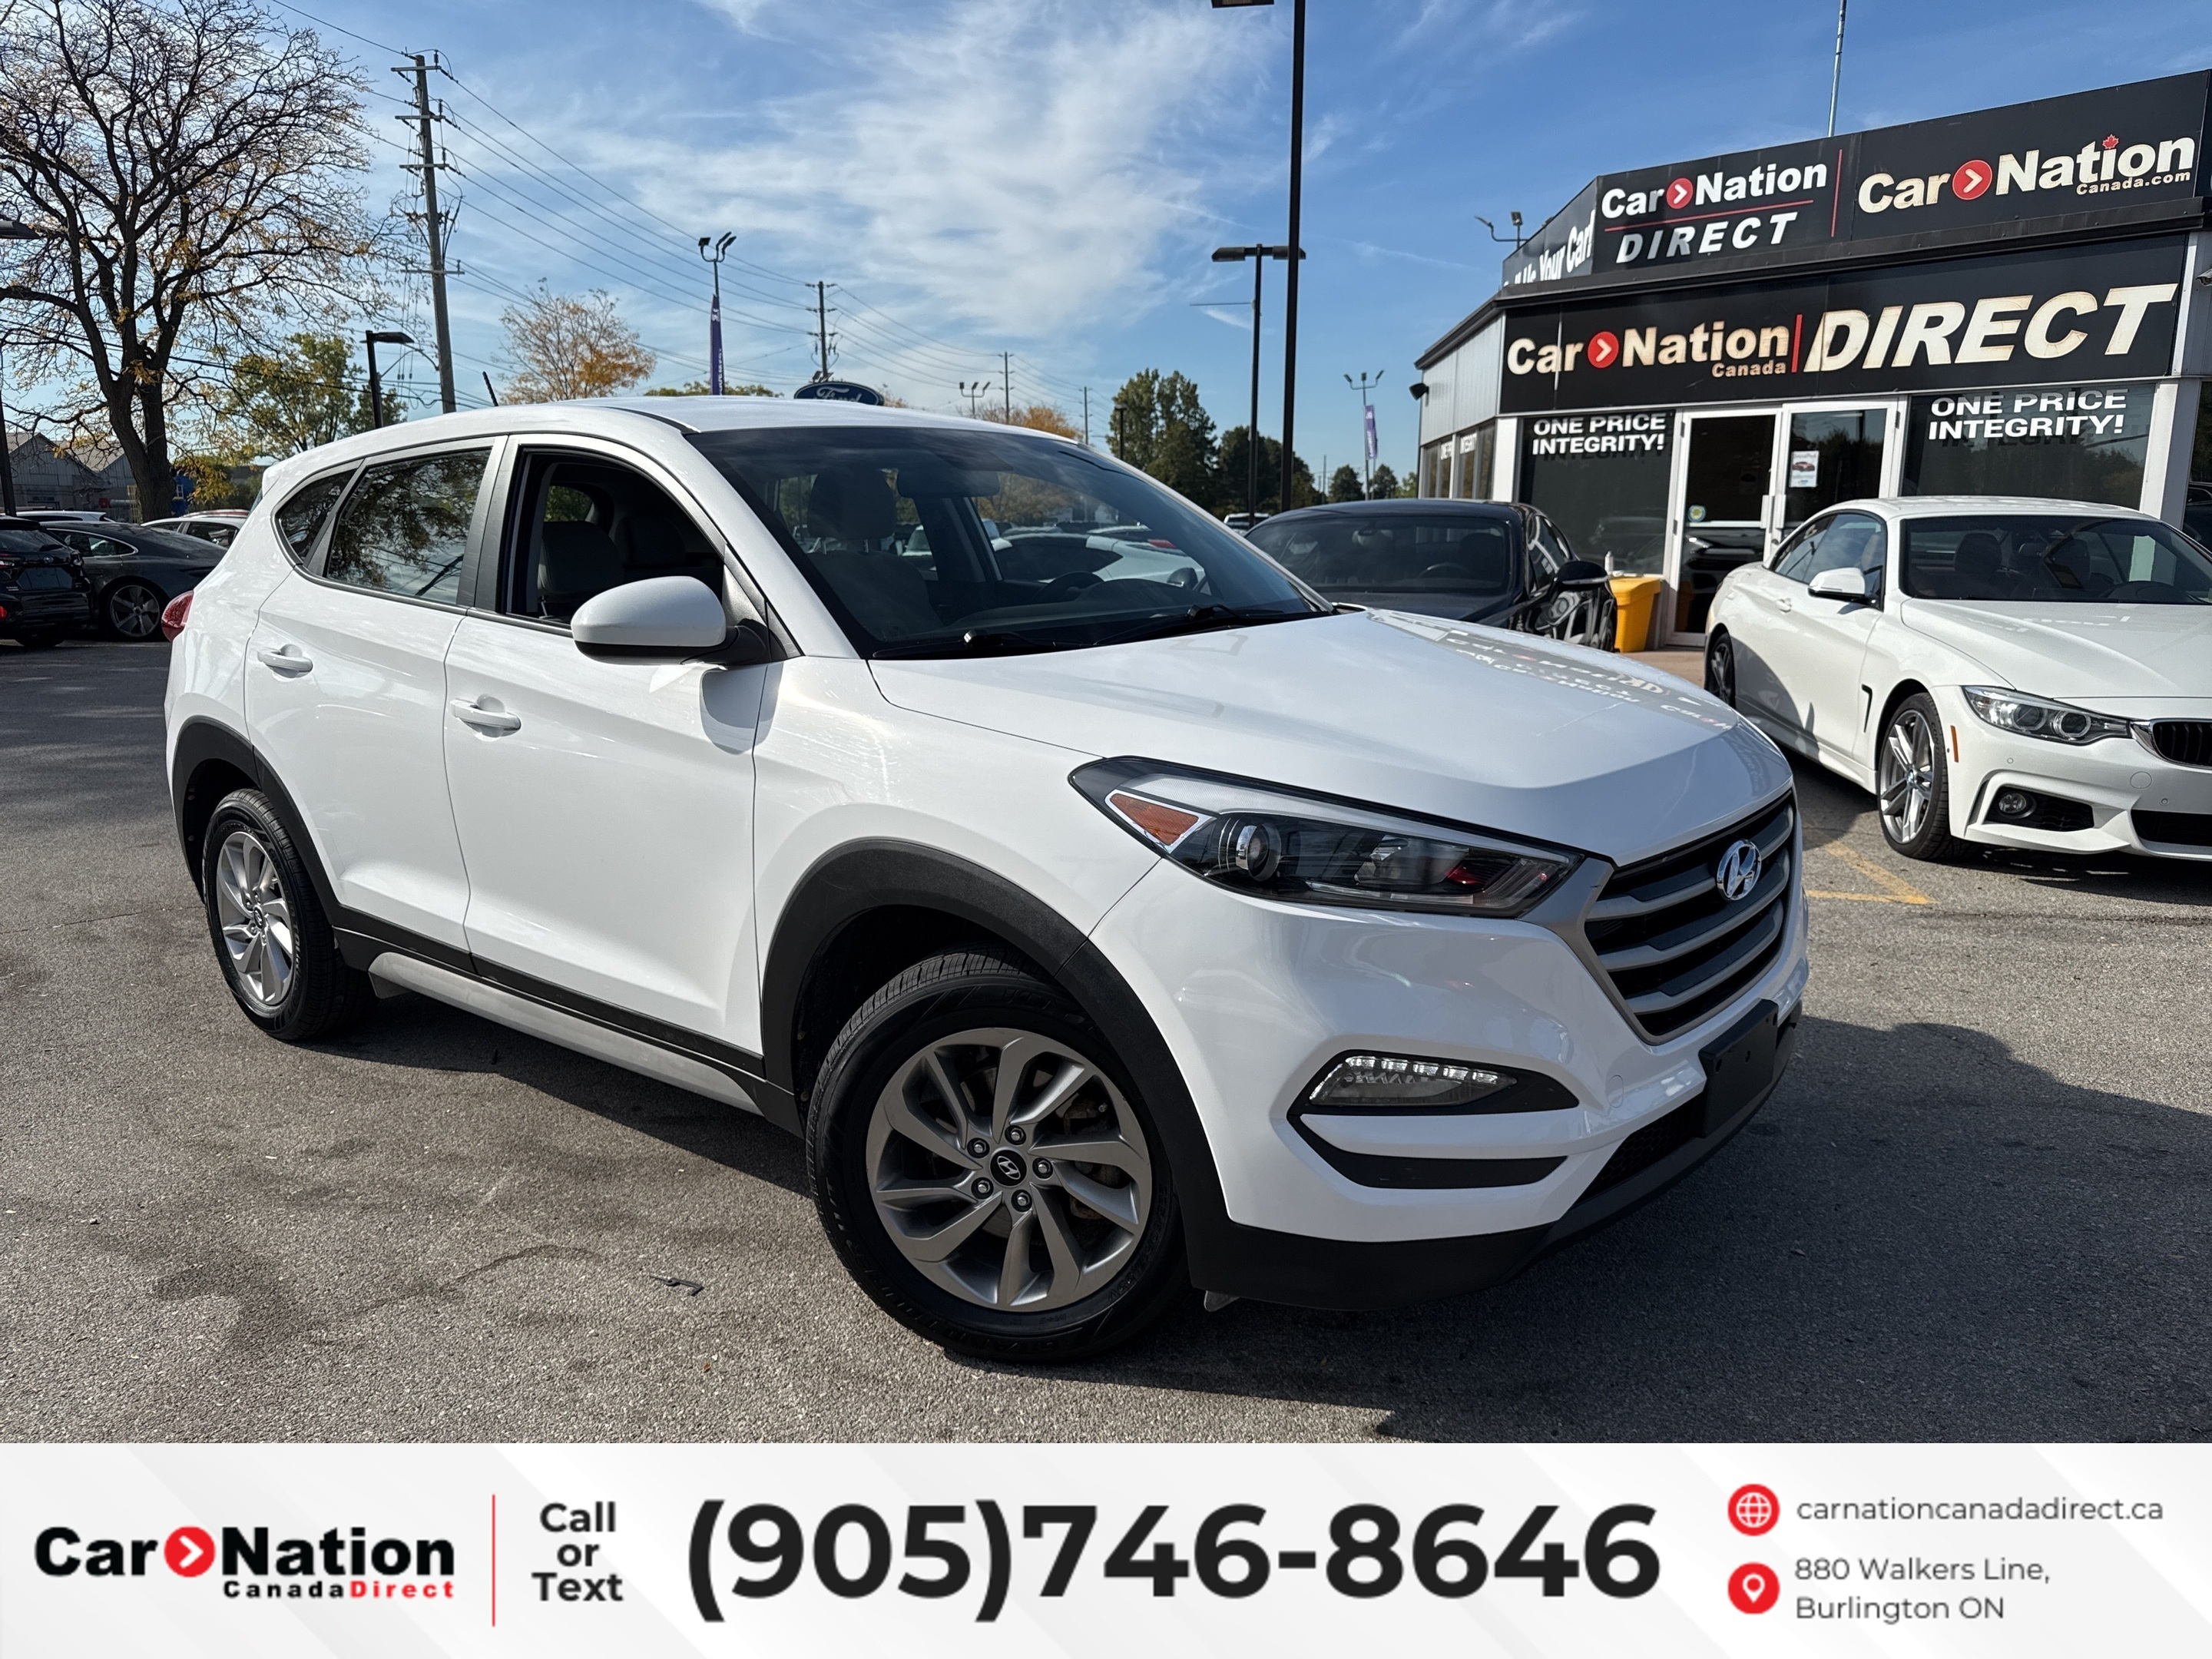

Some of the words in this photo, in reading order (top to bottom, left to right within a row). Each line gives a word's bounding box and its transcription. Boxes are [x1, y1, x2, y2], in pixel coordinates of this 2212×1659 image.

[1857, 172, 1951, 214] Car
[1995, 136, 2195, 196] Nation
[2075, 170, 2191, 196] Canada.com
[1601, 187, 1665, 219] Car
[1695, 163, 1827, 206] Nation
[1615, 211, 1798, 264] DIRECT
[1507, 337, 1584, 375] Car
[1622, 320, 1790, 368] Nation
[1803, 283, 2178, 373] DIRECT
[1711, 359, 1786, 378] Canada
[1931, 394, 2005, 417] ONE
[2013, 388, 2129, 413] PRICE
[1533, 416, 1584, 435] ONE
[1589, 412, 1667, 433] PRICE
[1928, 414, 2124, 440] INTEGRITY!
[1532, 433, 1665, 455] INTEGRITY!
